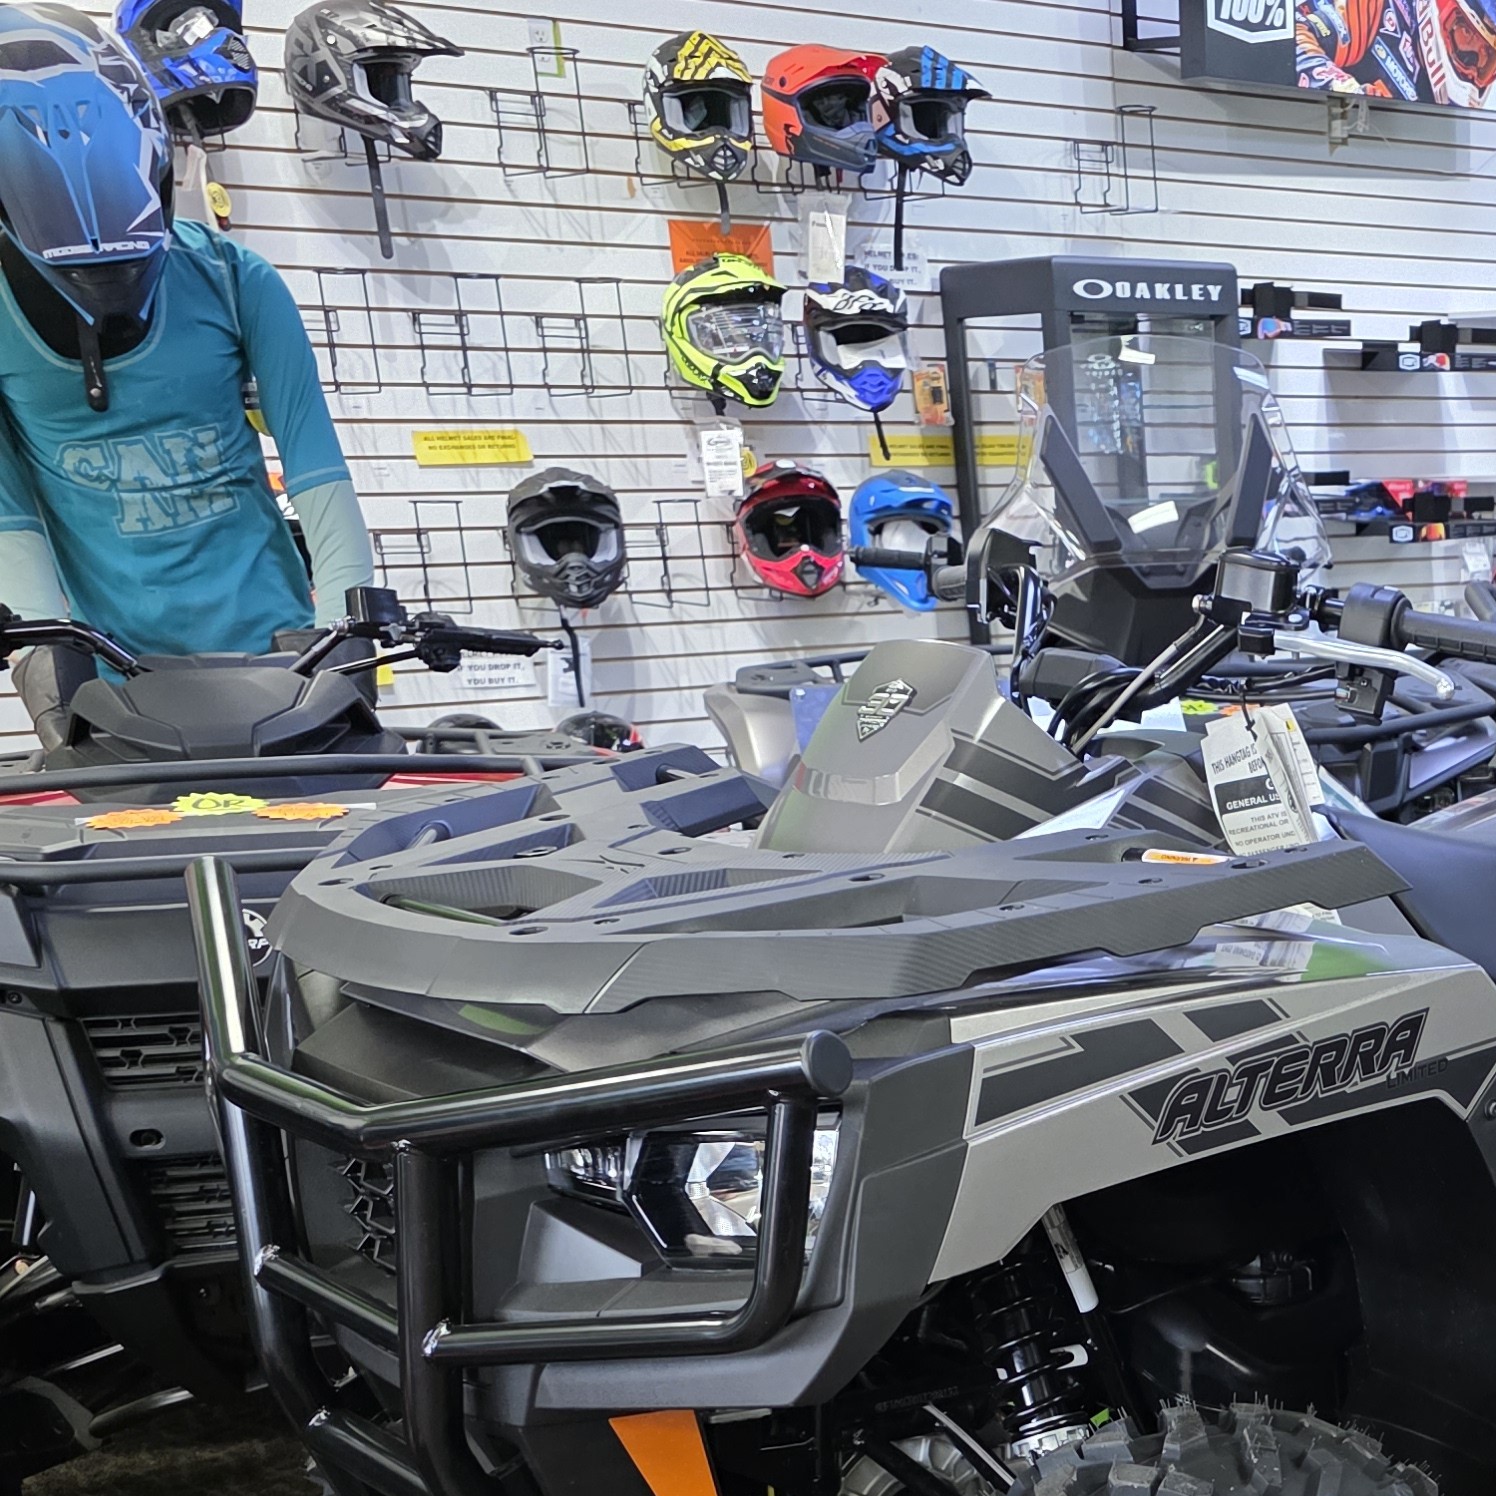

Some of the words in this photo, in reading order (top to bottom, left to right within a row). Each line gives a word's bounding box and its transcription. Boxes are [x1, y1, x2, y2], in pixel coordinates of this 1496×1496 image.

[1115, 280, 1223, 301] OAKLEY
[57, 423, 230, 493] CAN
[467, 664, 486, 672] YOU
[488, 663, 511, 671] DROP
[488, 677, 506, 685] BUY
[1211, 760, 1225, 775] THIS
[1224, 745, 1251, 769] HANGTAG
[1249, 743, 1258, 756] IS
[1226, 796, 1269, 811] GENERAL
[1251, 814, 1266, 823] THIS
[1267, 811, 1280, 820] ATV
[1228, 822, 1278, 835] RECREATIONAL
[1279, 818, 1289, 827] OR
[1244, 833, 1280, 847] OPERATOR
[1152, 1007, 1430, 1146] ALTERRA
[1386, 1057, 1450, 1090] LIMITED
